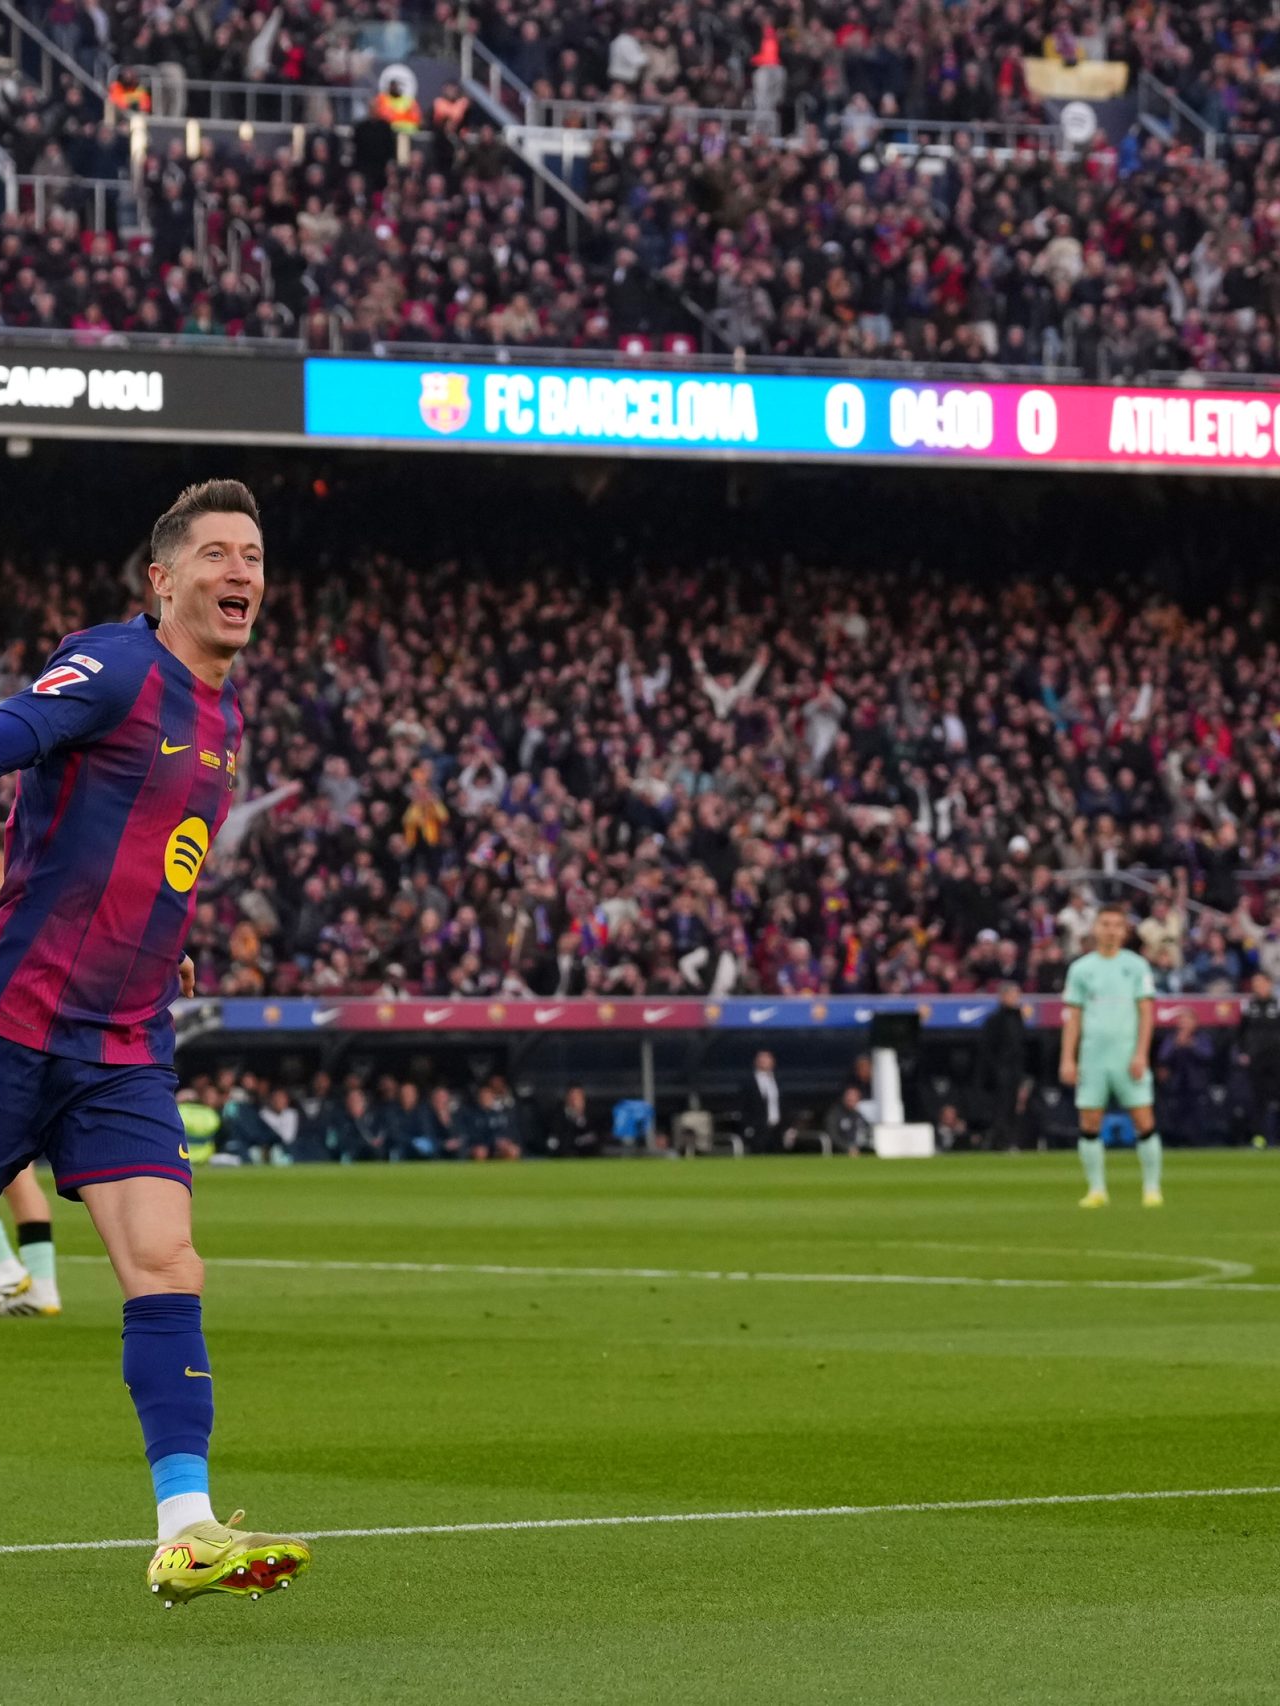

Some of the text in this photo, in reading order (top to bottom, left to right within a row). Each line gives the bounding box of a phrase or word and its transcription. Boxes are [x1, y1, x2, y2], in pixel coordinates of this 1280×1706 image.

[88, 369, 163, 412] NOU
[484, 374, 534, 434] FC
[539, 376, 758, 441] BARCELONA
[825, 383, 866, 448] 0
[889, 388, 994, 450] 04:00
[1017, 389, 1058, 454] 0
[1108, 396, 1272, 459] ATHLETIC
